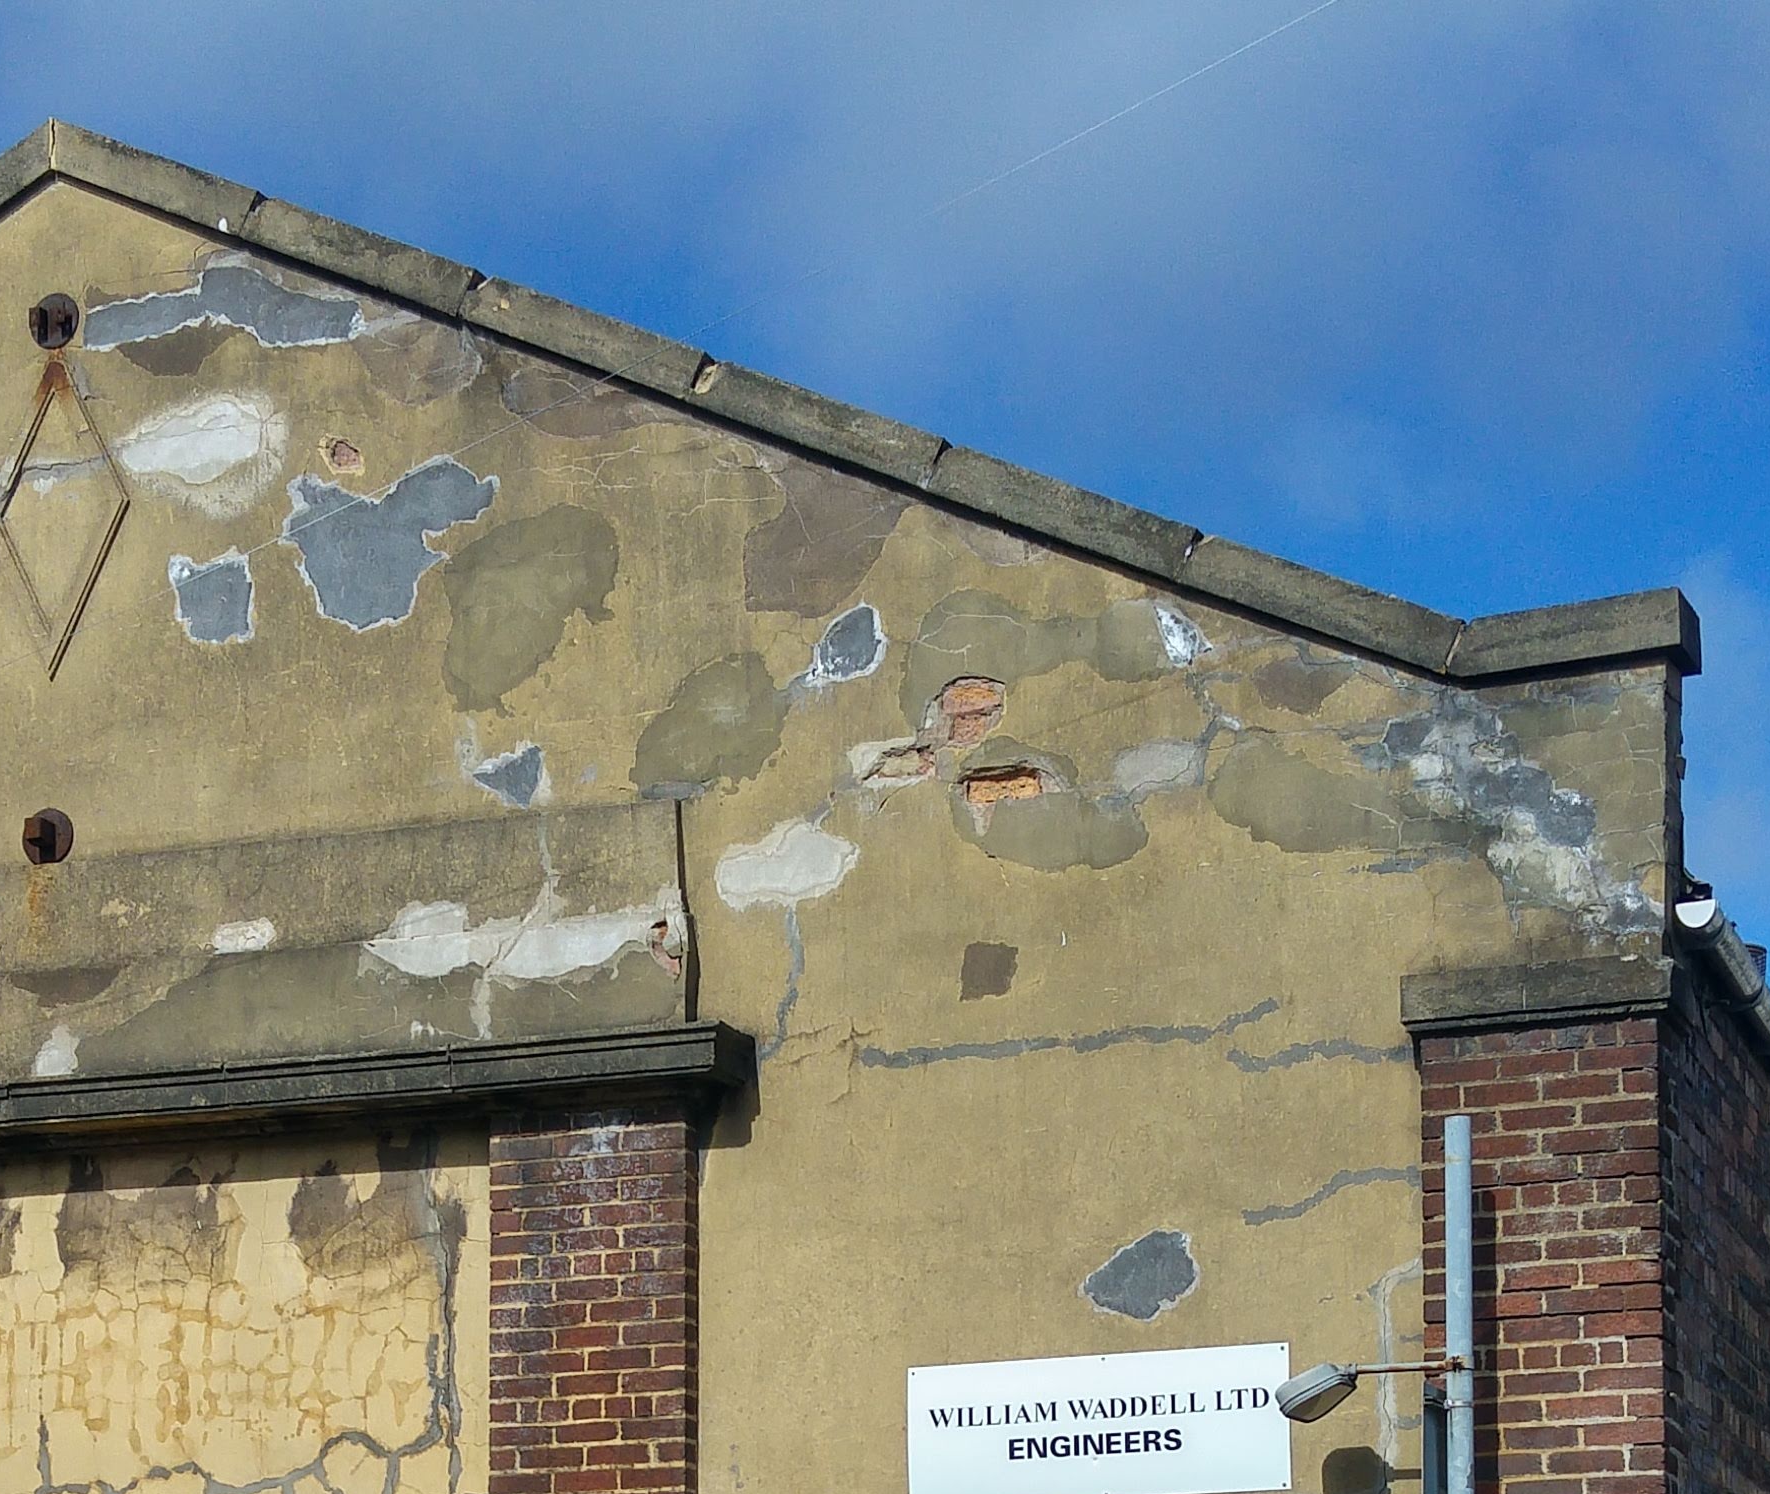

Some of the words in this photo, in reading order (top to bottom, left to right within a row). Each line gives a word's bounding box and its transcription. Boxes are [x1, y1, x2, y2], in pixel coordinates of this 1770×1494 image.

[928, 1401, 1058, 1428] WILLIAM
[1068, 1391, 1205, 1420] WADDELL
[1215, 1387, 1270, 1411] LTD
[1008, 1428, 1182, 1460] ENGINEERS
